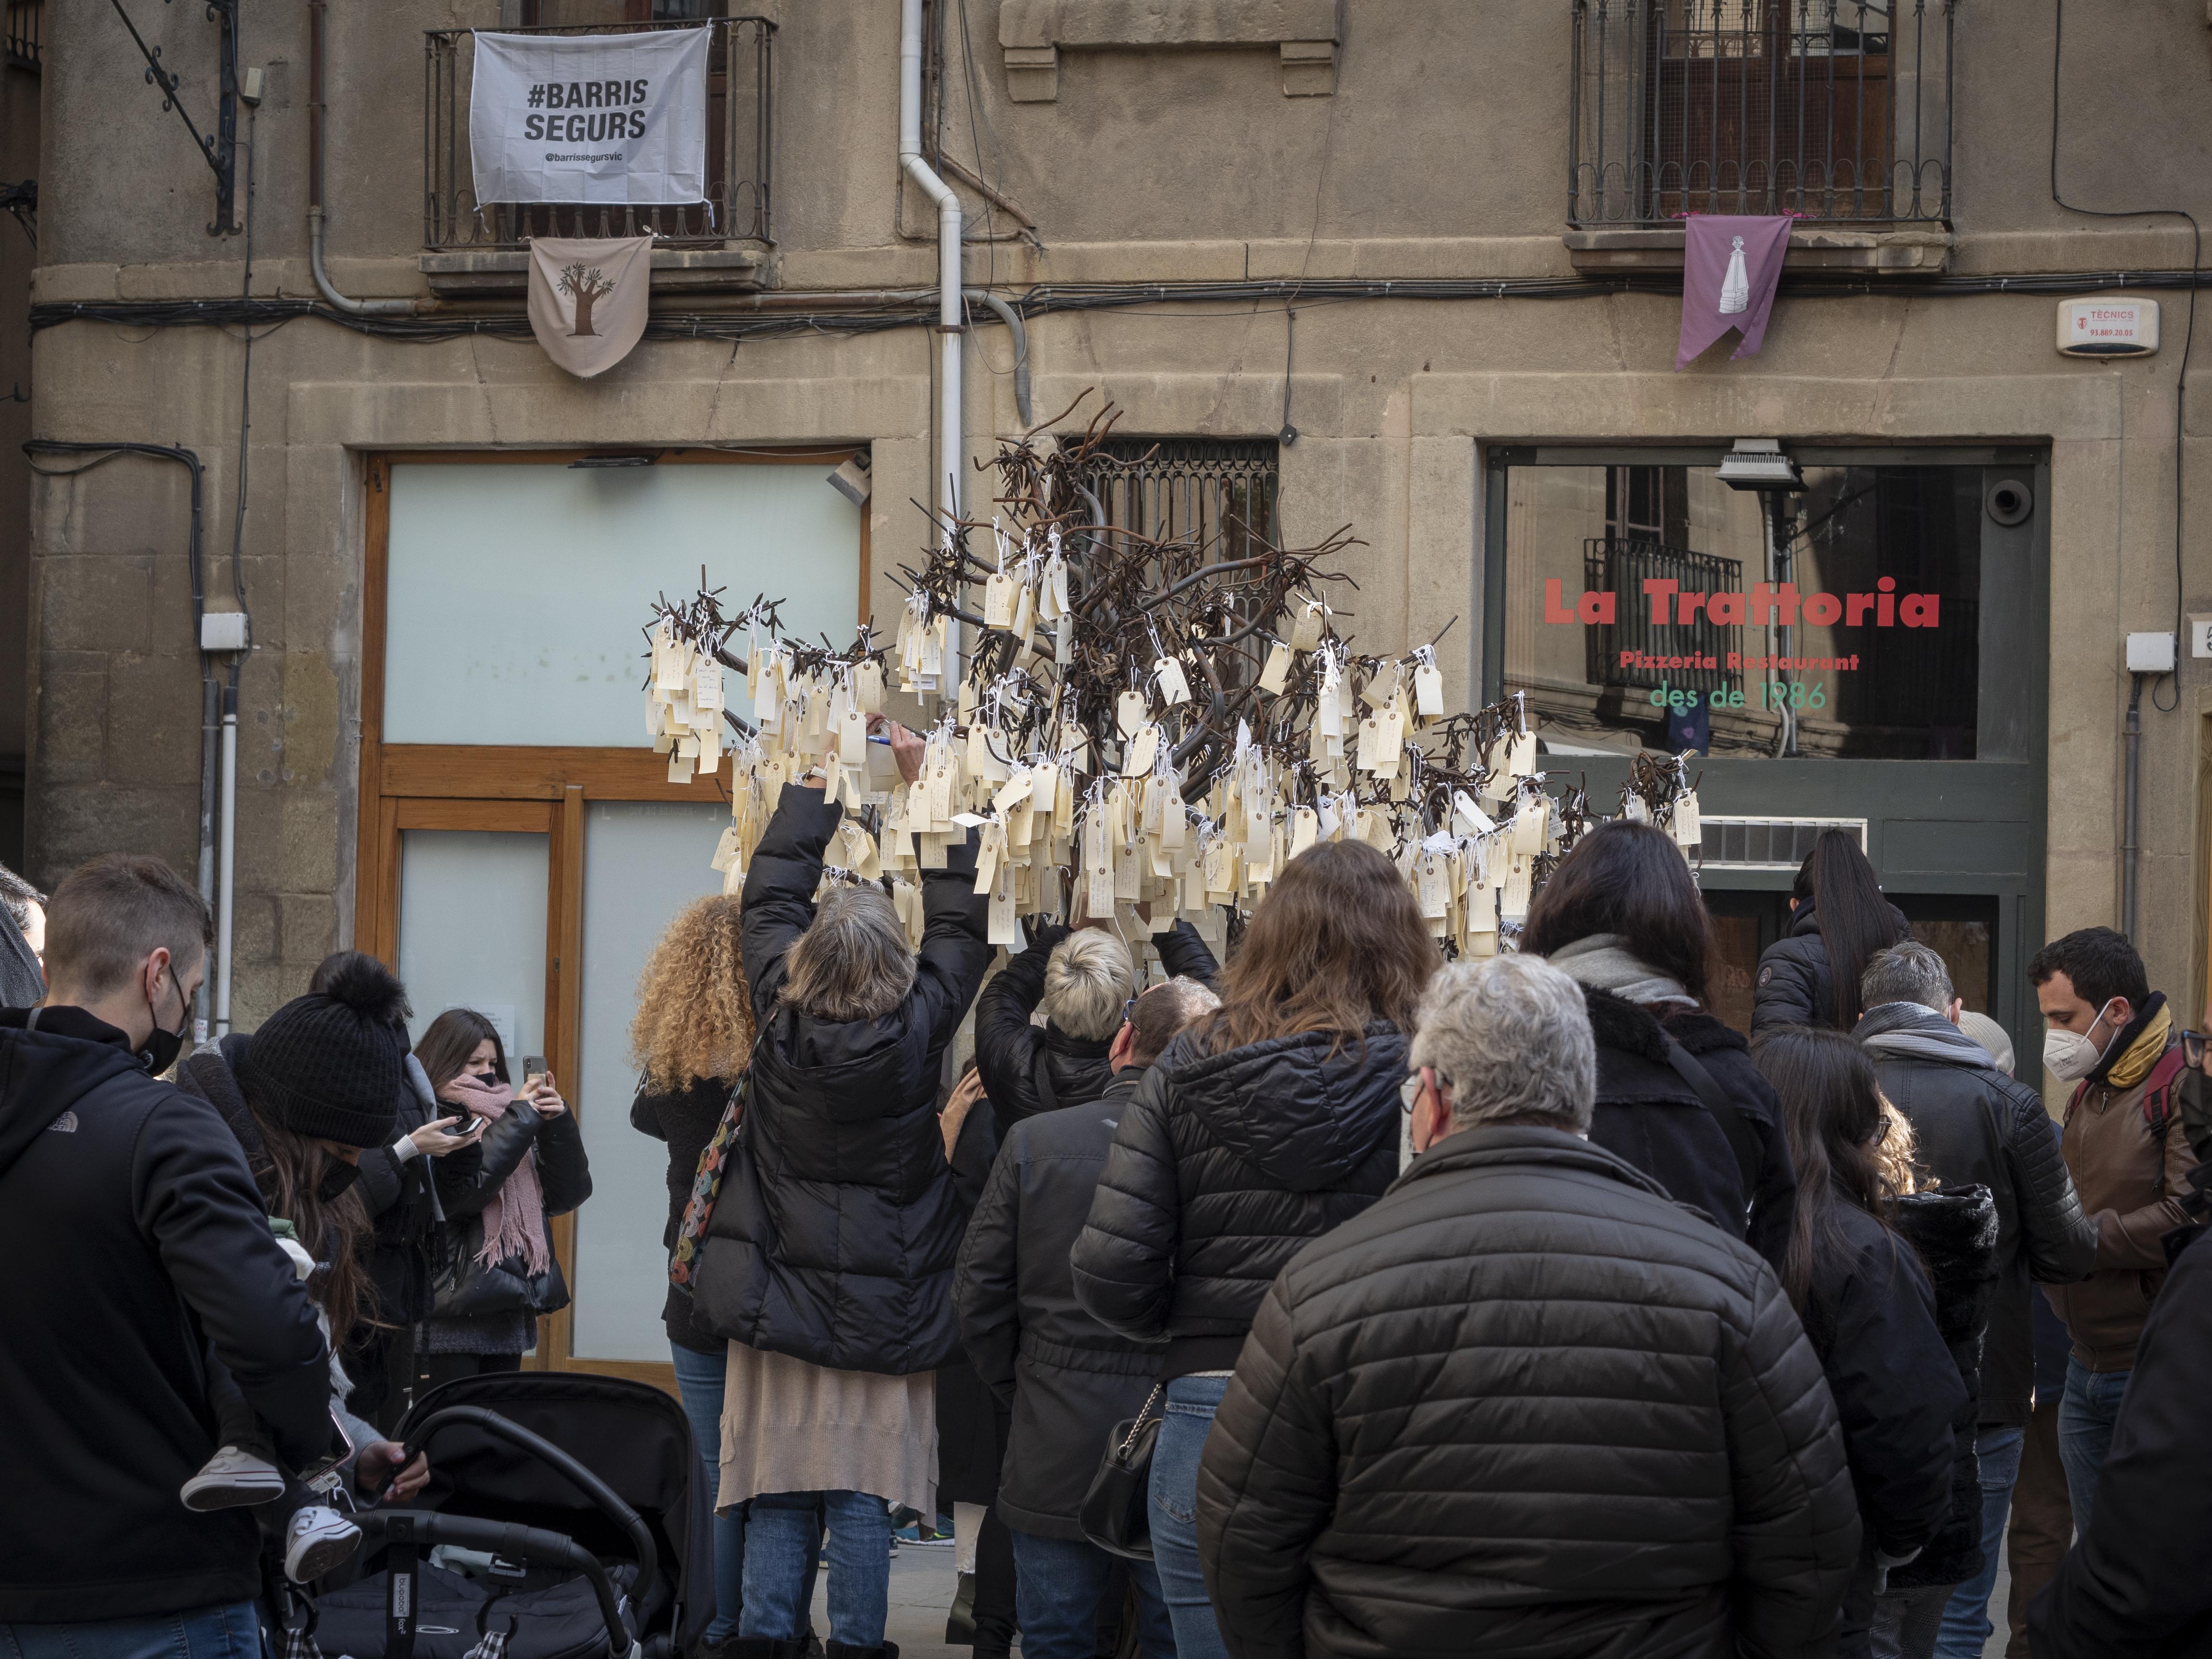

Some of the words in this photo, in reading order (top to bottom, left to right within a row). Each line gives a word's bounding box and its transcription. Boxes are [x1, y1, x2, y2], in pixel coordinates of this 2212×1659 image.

[528, 79, 648, 108] #BARRIS
[524, 109, 646, 142] SEGURS
[545, 152, 622, 163] @barrissegursvic
[2091, 309, 2133, 318] TÈCNICS
[1544, 578, 1616, 625] La
[1643, 577, 1940, 627] Trattoria
[1620, 650, 1717, 670] Pizzeria
[1727, 653, 1859, 671] Restaurant
[1650, 681, 1698, 708] des
[1710, 682, 1745, 709] de
[1759, 681, 1826, 709] 1986
